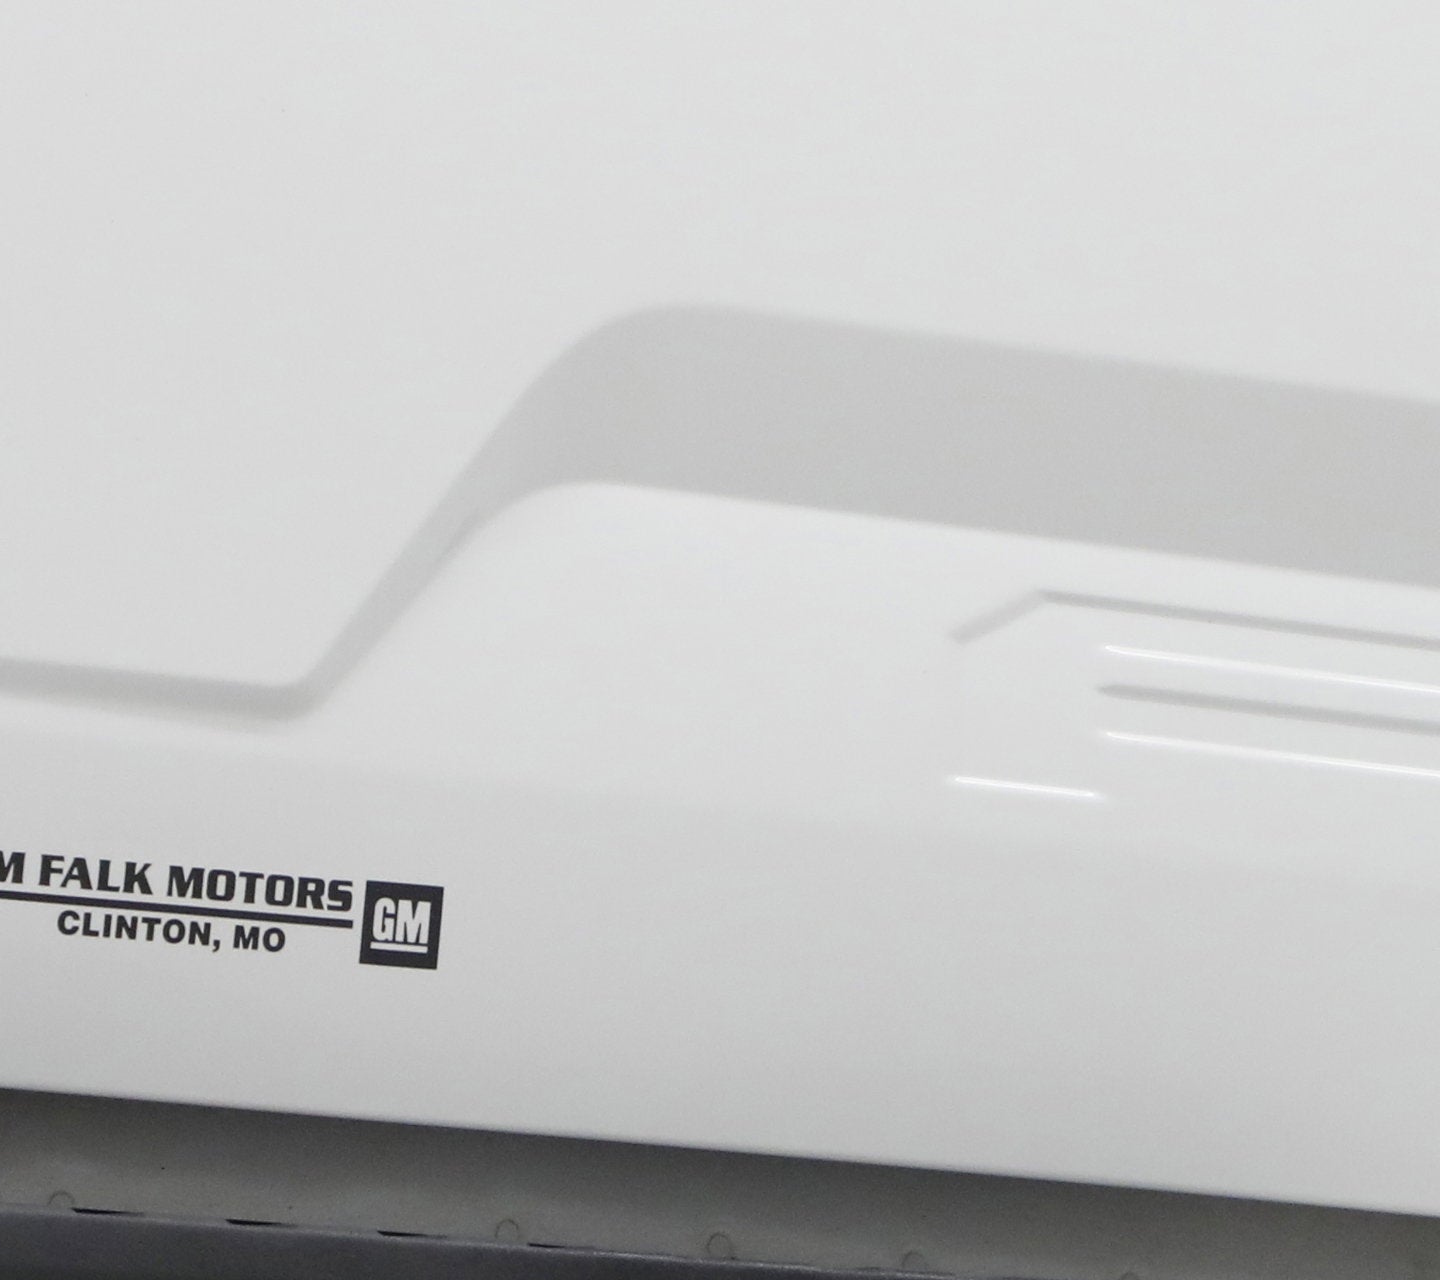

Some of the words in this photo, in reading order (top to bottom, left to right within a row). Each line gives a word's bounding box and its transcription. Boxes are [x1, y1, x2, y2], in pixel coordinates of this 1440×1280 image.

[37, 853, 154, 895] FALK
[166, 865, 354, 912] MOTORS
[56, 910, 221, 953] CLINTON,
[231, 926, 287, 953] MO
